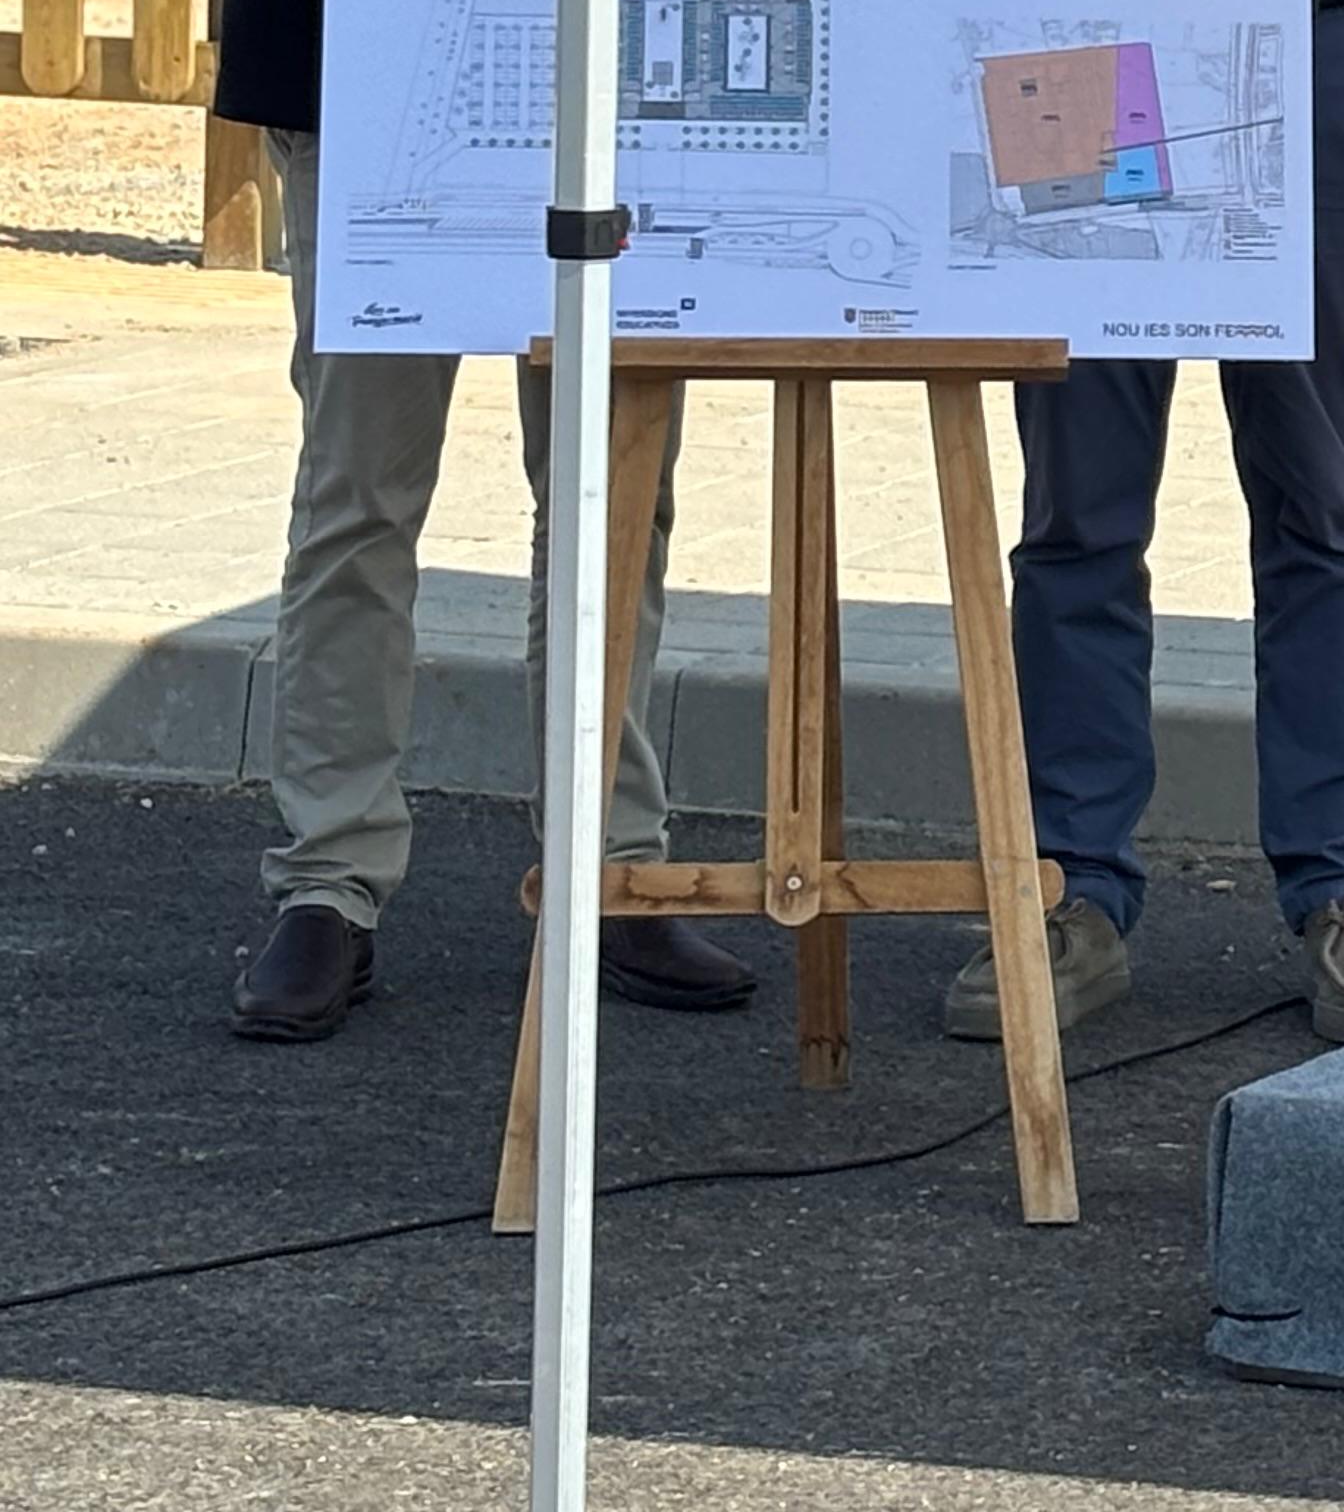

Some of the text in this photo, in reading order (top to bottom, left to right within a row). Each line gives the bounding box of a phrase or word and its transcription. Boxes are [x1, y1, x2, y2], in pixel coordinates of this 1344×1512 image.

[1102, 323, 1140, 338] NOU
[1144, 323, 1171, 338] IES
[1174, 323, 1211, 338] SON
